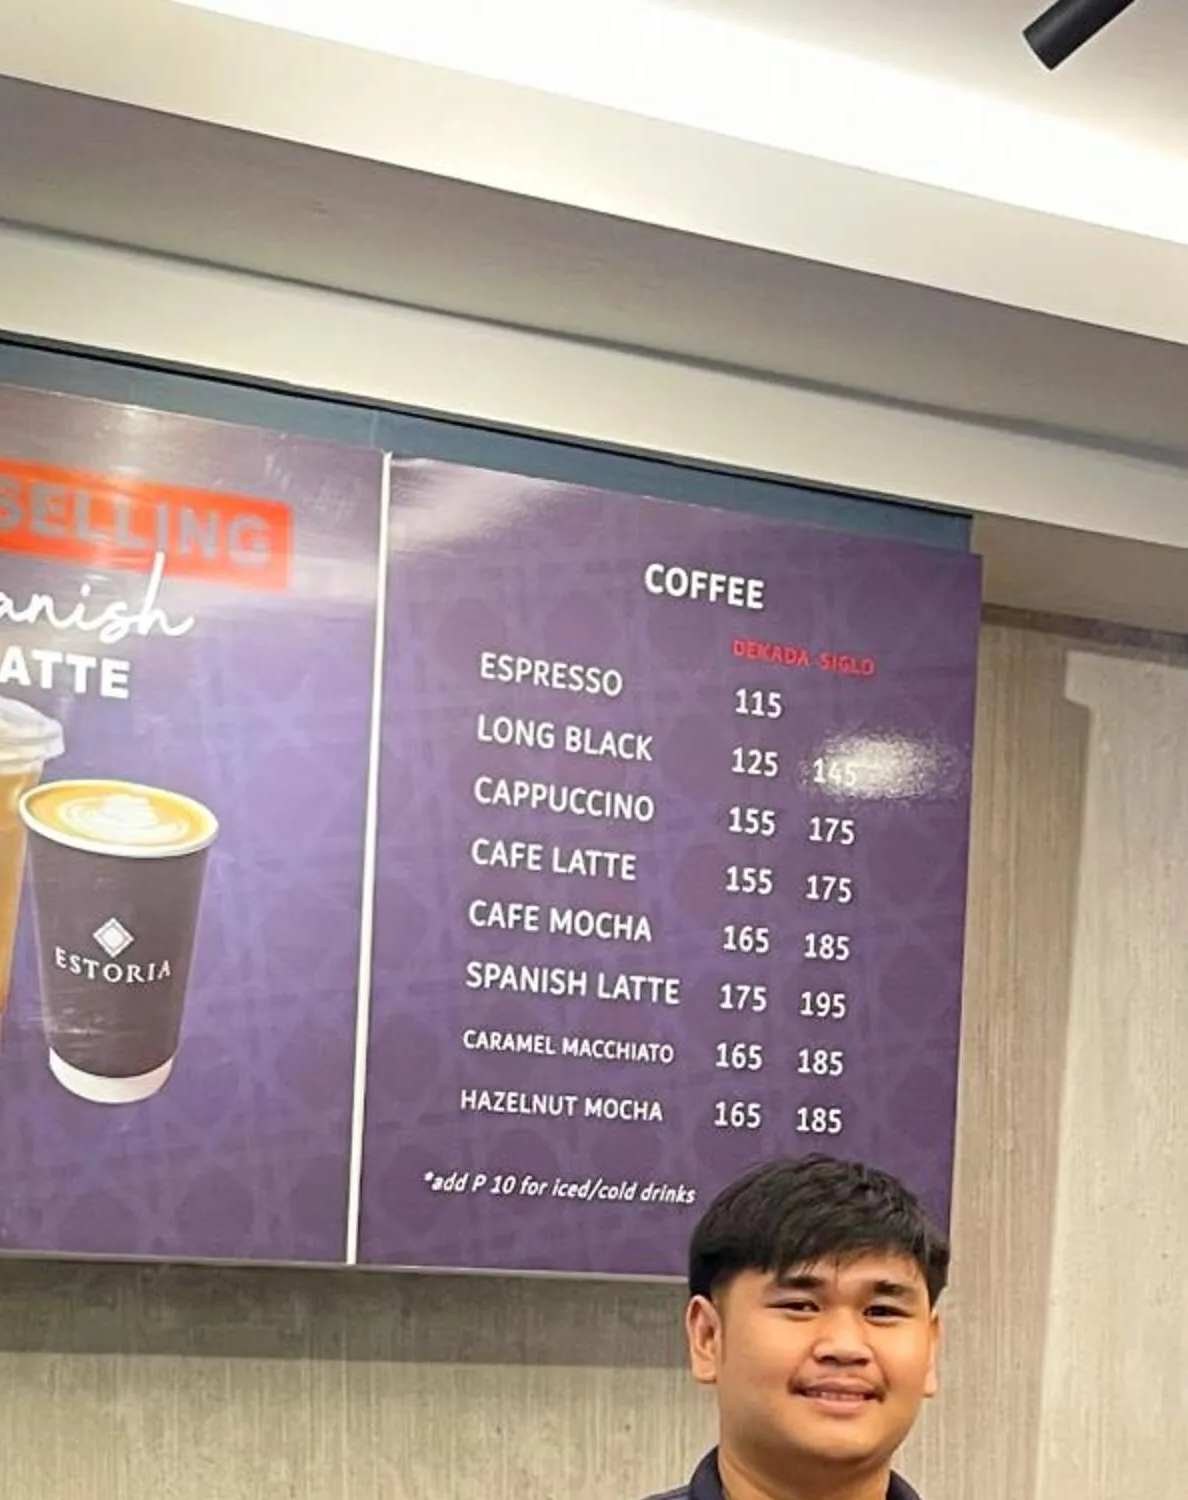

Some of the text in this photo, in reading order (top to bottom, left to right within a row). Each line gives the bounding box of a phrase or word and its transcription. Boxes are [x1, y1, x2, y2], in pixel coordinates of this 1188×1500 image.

[645, 563, 764, 610] COFFEE
[732, 639, 875, 676] DEKADA SIGLO
[480, 652, 782, 718] ESPRESSO 115
[477, 715, 858, 788] LONG BLACK 125 145
[475, 777, 855, 846] CAPPUCCINO 155 175
[472, 838, 852, 903] CAFE LATTE 155 175
[469, 900, 850, 962] CAFE MOCHA 165 185
[55, 948, 172, 983] ESTORIA
[465, 961, 846, 1019] SPANISH LATTE 175 195
[463, 1030, 843, 1077] CARAMEL MACCHIATO 165 185
[461, 1089, 842, 1134] HAZELNUT MOCHA 165 185
[471, 1174, 487, 1193] P
[492, 1175, 516, 1195] 10
[521, 1176, 548, 1197] for
[552, 1178, 636, 1202] iced/cold
[641, 1182, 695, 1204] drinks
